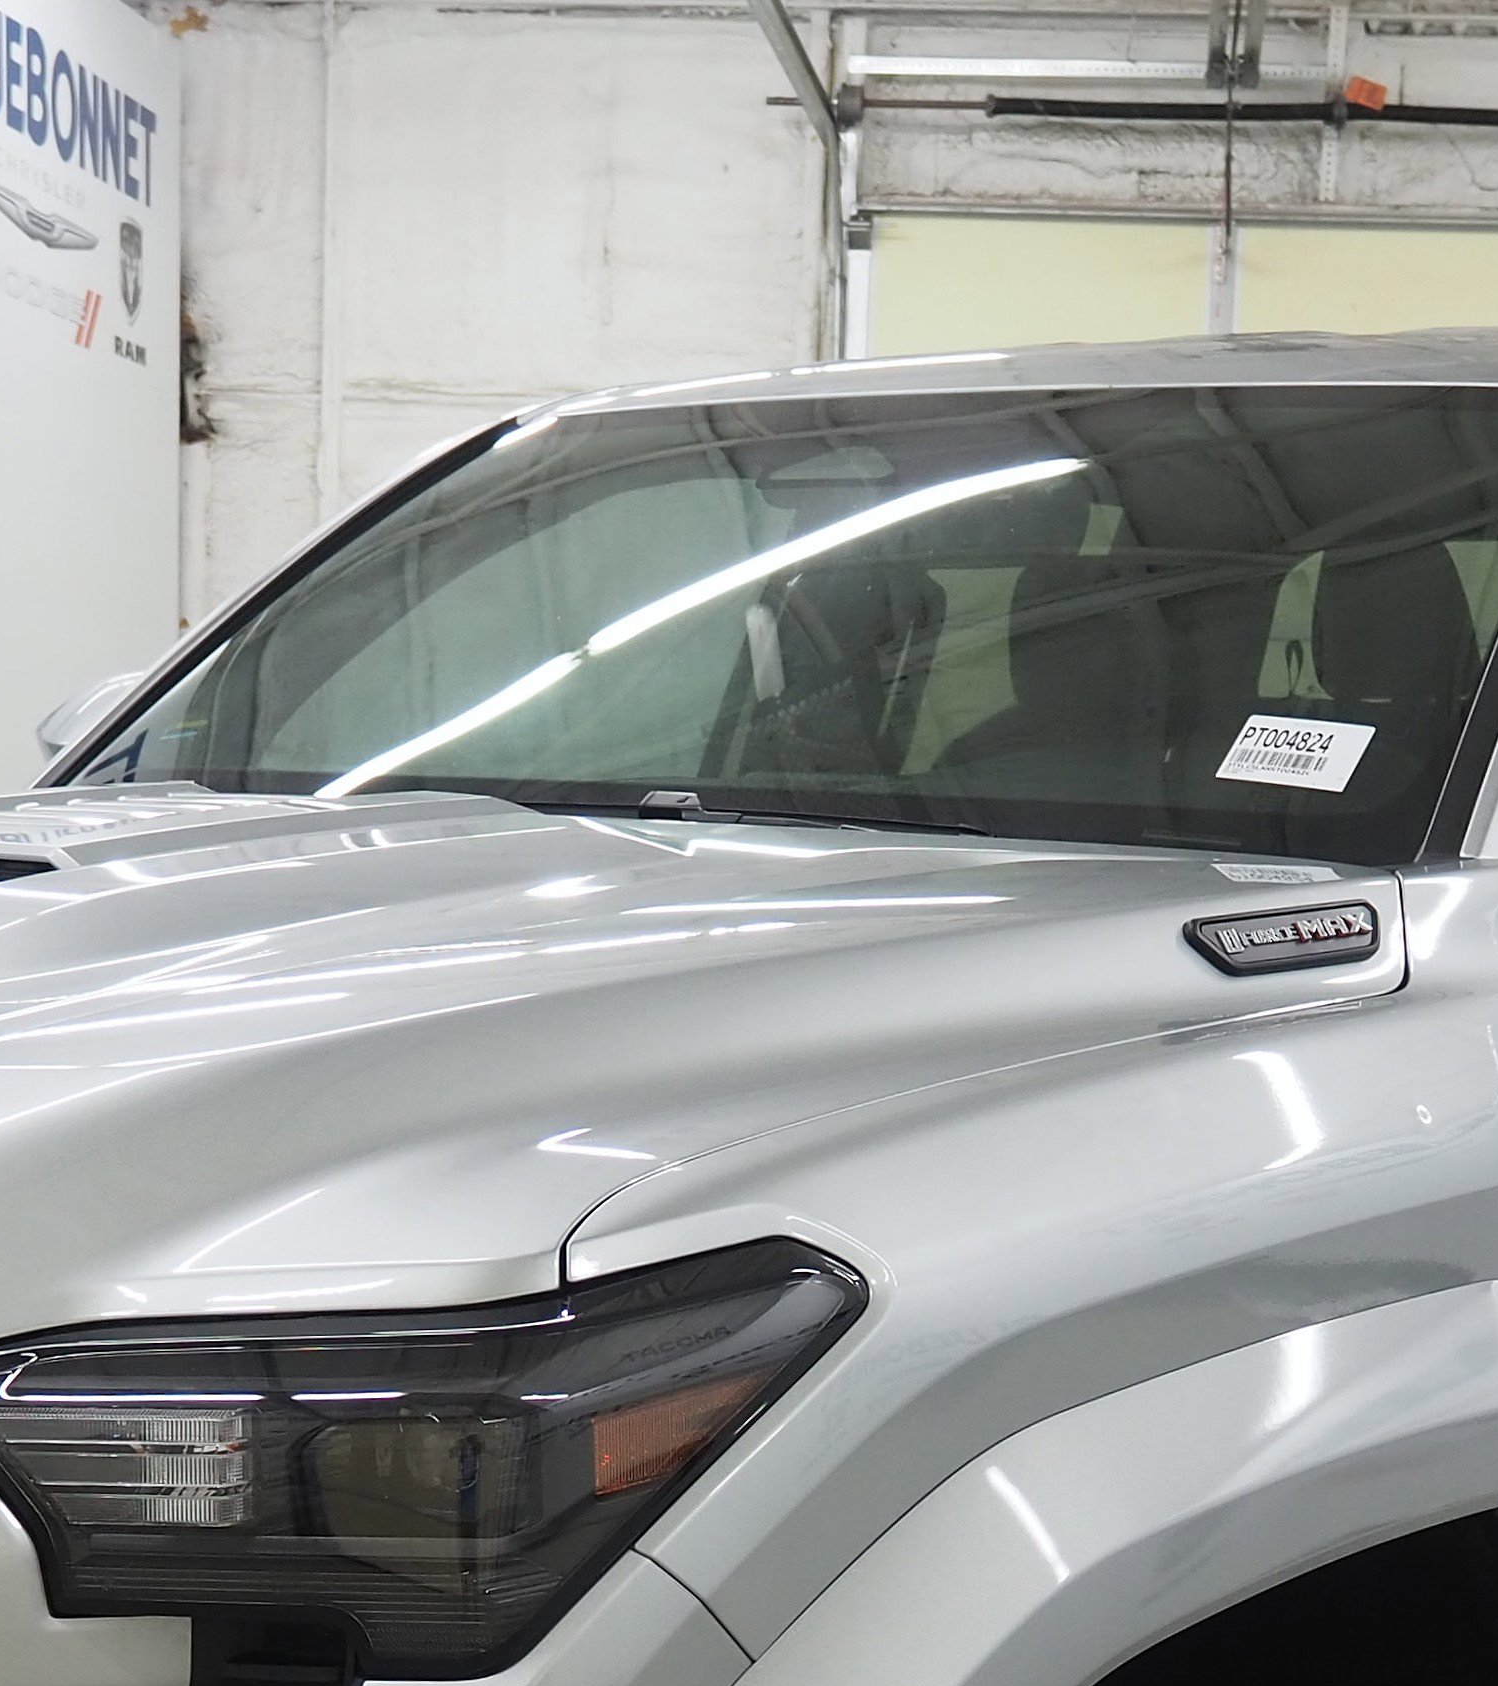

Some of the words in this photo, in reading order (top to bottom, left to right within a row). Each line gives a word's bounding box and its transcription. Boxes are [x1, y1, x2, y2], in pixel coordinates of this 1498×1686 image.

[114, 335, 147, 366] RAM
[1239, 726, 1334, 754] PT004824
[623, 1325, 731, 1361] TACOMA
